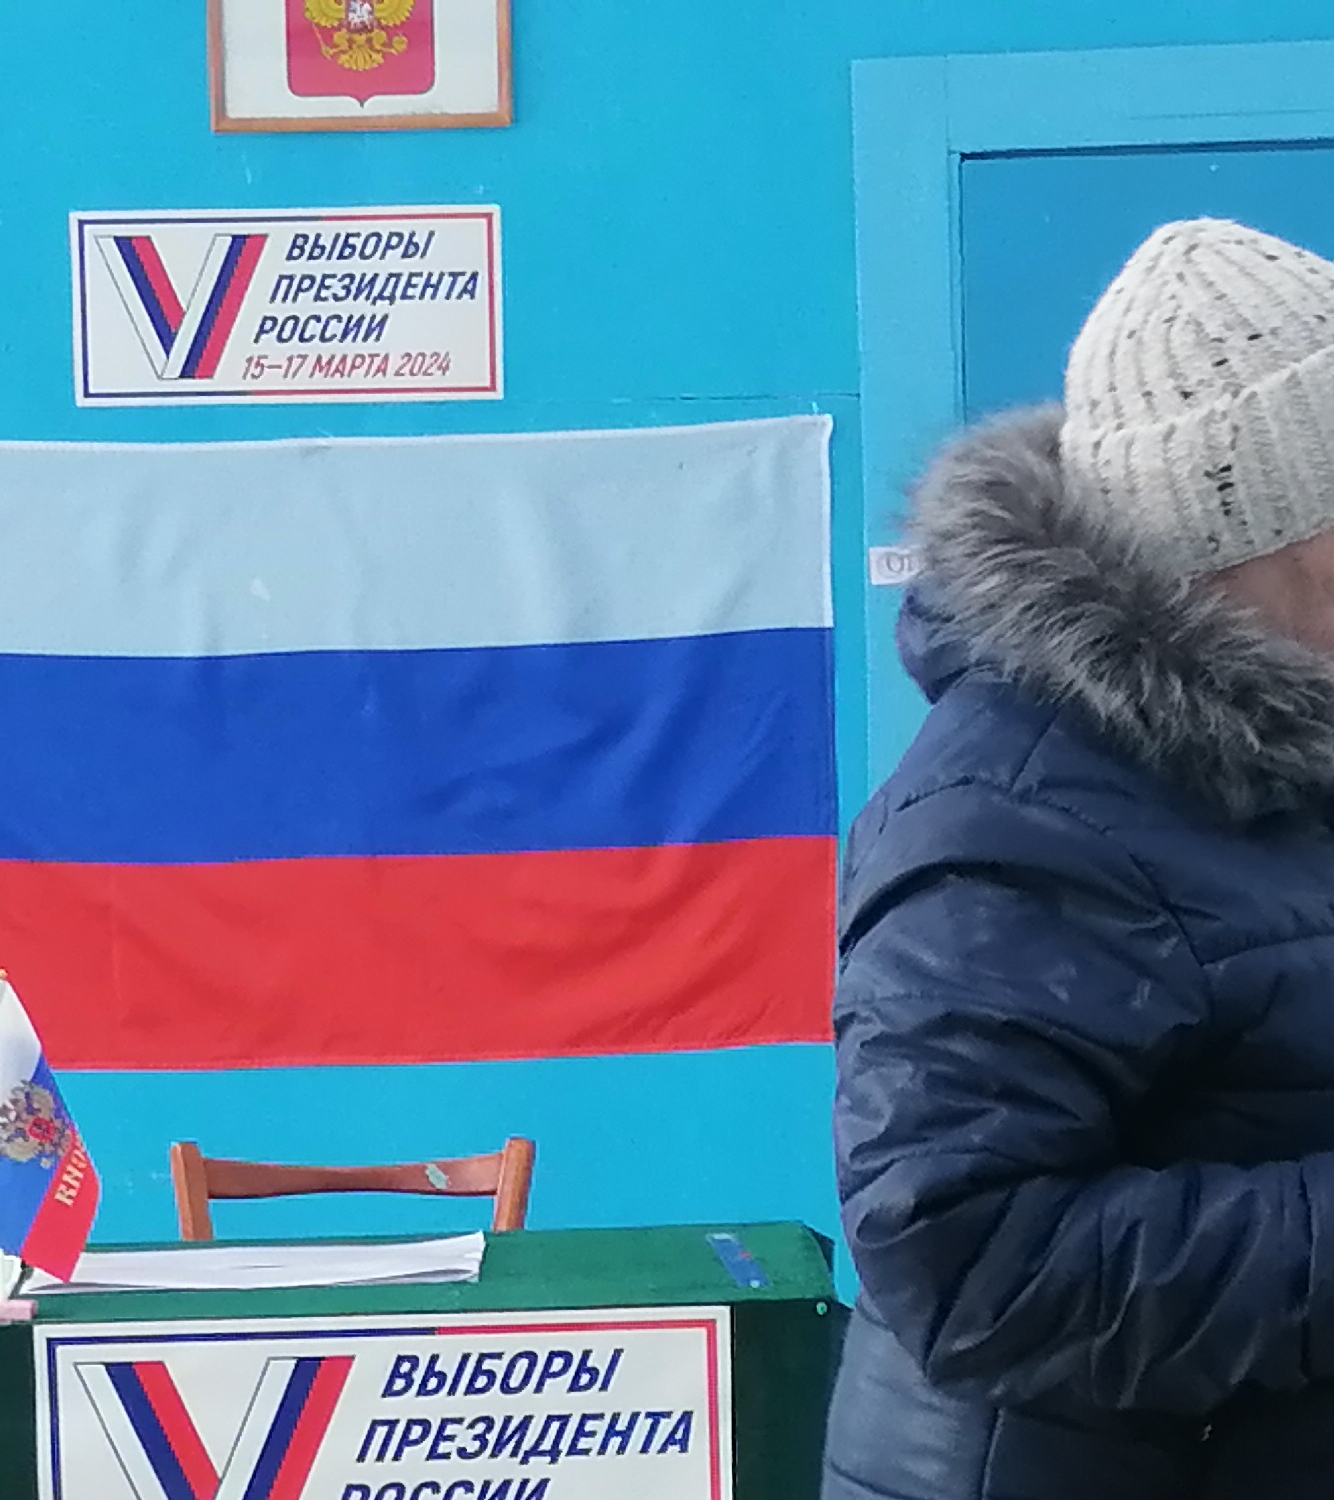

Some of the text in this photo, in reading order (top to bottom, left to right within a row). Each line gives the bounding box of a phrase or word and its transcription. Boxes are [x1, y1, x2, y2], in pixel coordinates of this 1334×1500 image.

[285, 230, 436, 262] ВЫБОРЫ
[268, 270, 480, 307] ПРЕЗИДЕНТА
[253, 313, 389, 344] РОССИИ
[308, 352, 389, 379] МАРТА
[393, 351, 451, 377] 2024
[380, 1347, 625, 1399] ВЫБОРЫ
[355, 1409, 694, 1466] ПРЕЗИДЕНТА
